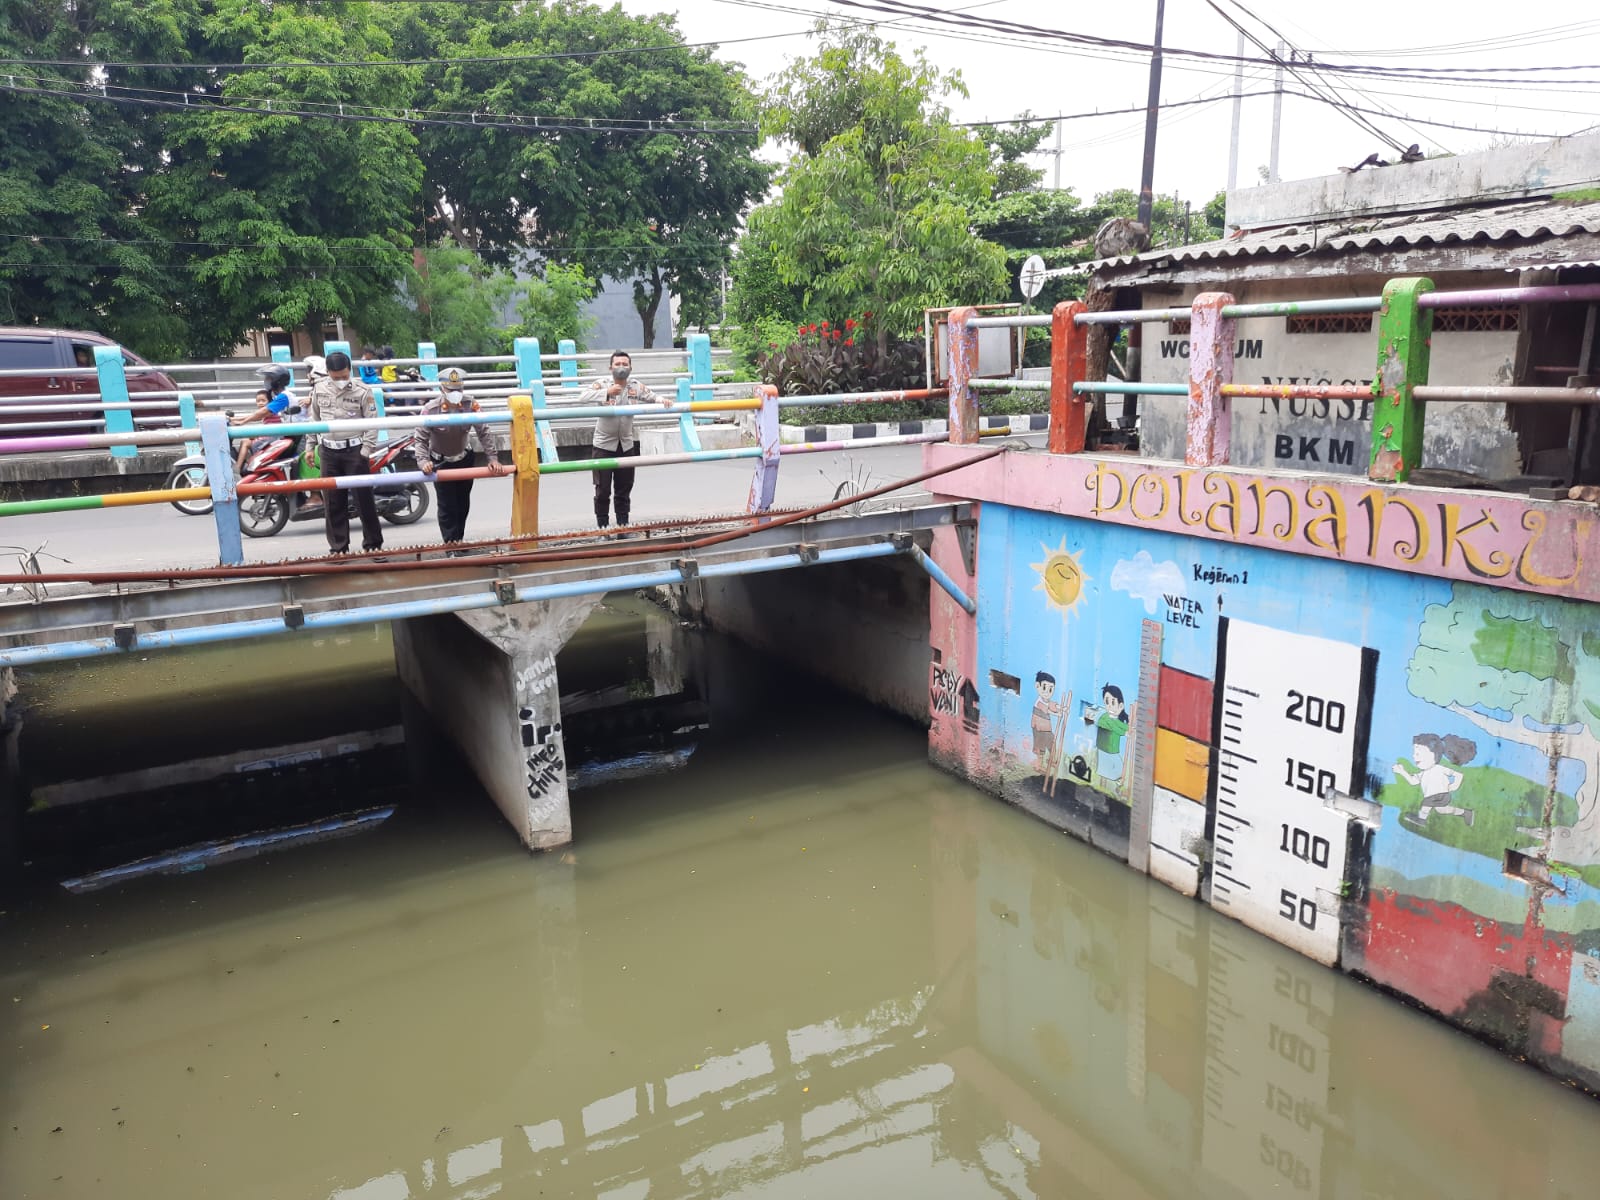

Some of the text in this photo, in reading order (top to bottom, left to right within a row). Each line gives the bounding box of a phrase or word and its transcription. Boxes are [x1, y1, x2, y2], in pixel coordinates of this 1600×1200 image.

[1161, 340, 1190, 358] WC
[1275, 434, 1354, 466] BKM
[1242, 570, 1248, 584] 1
[1163, 593, 1203, 614] WATER
[1166, 609, 1200, 628] LEVEL
[1286, 689, 1345, 733] 200
[1285, 757, 1335, 800] 150
[1280, 823, 1330, 869] 100
[1279, 888, 1317, 931] 50
